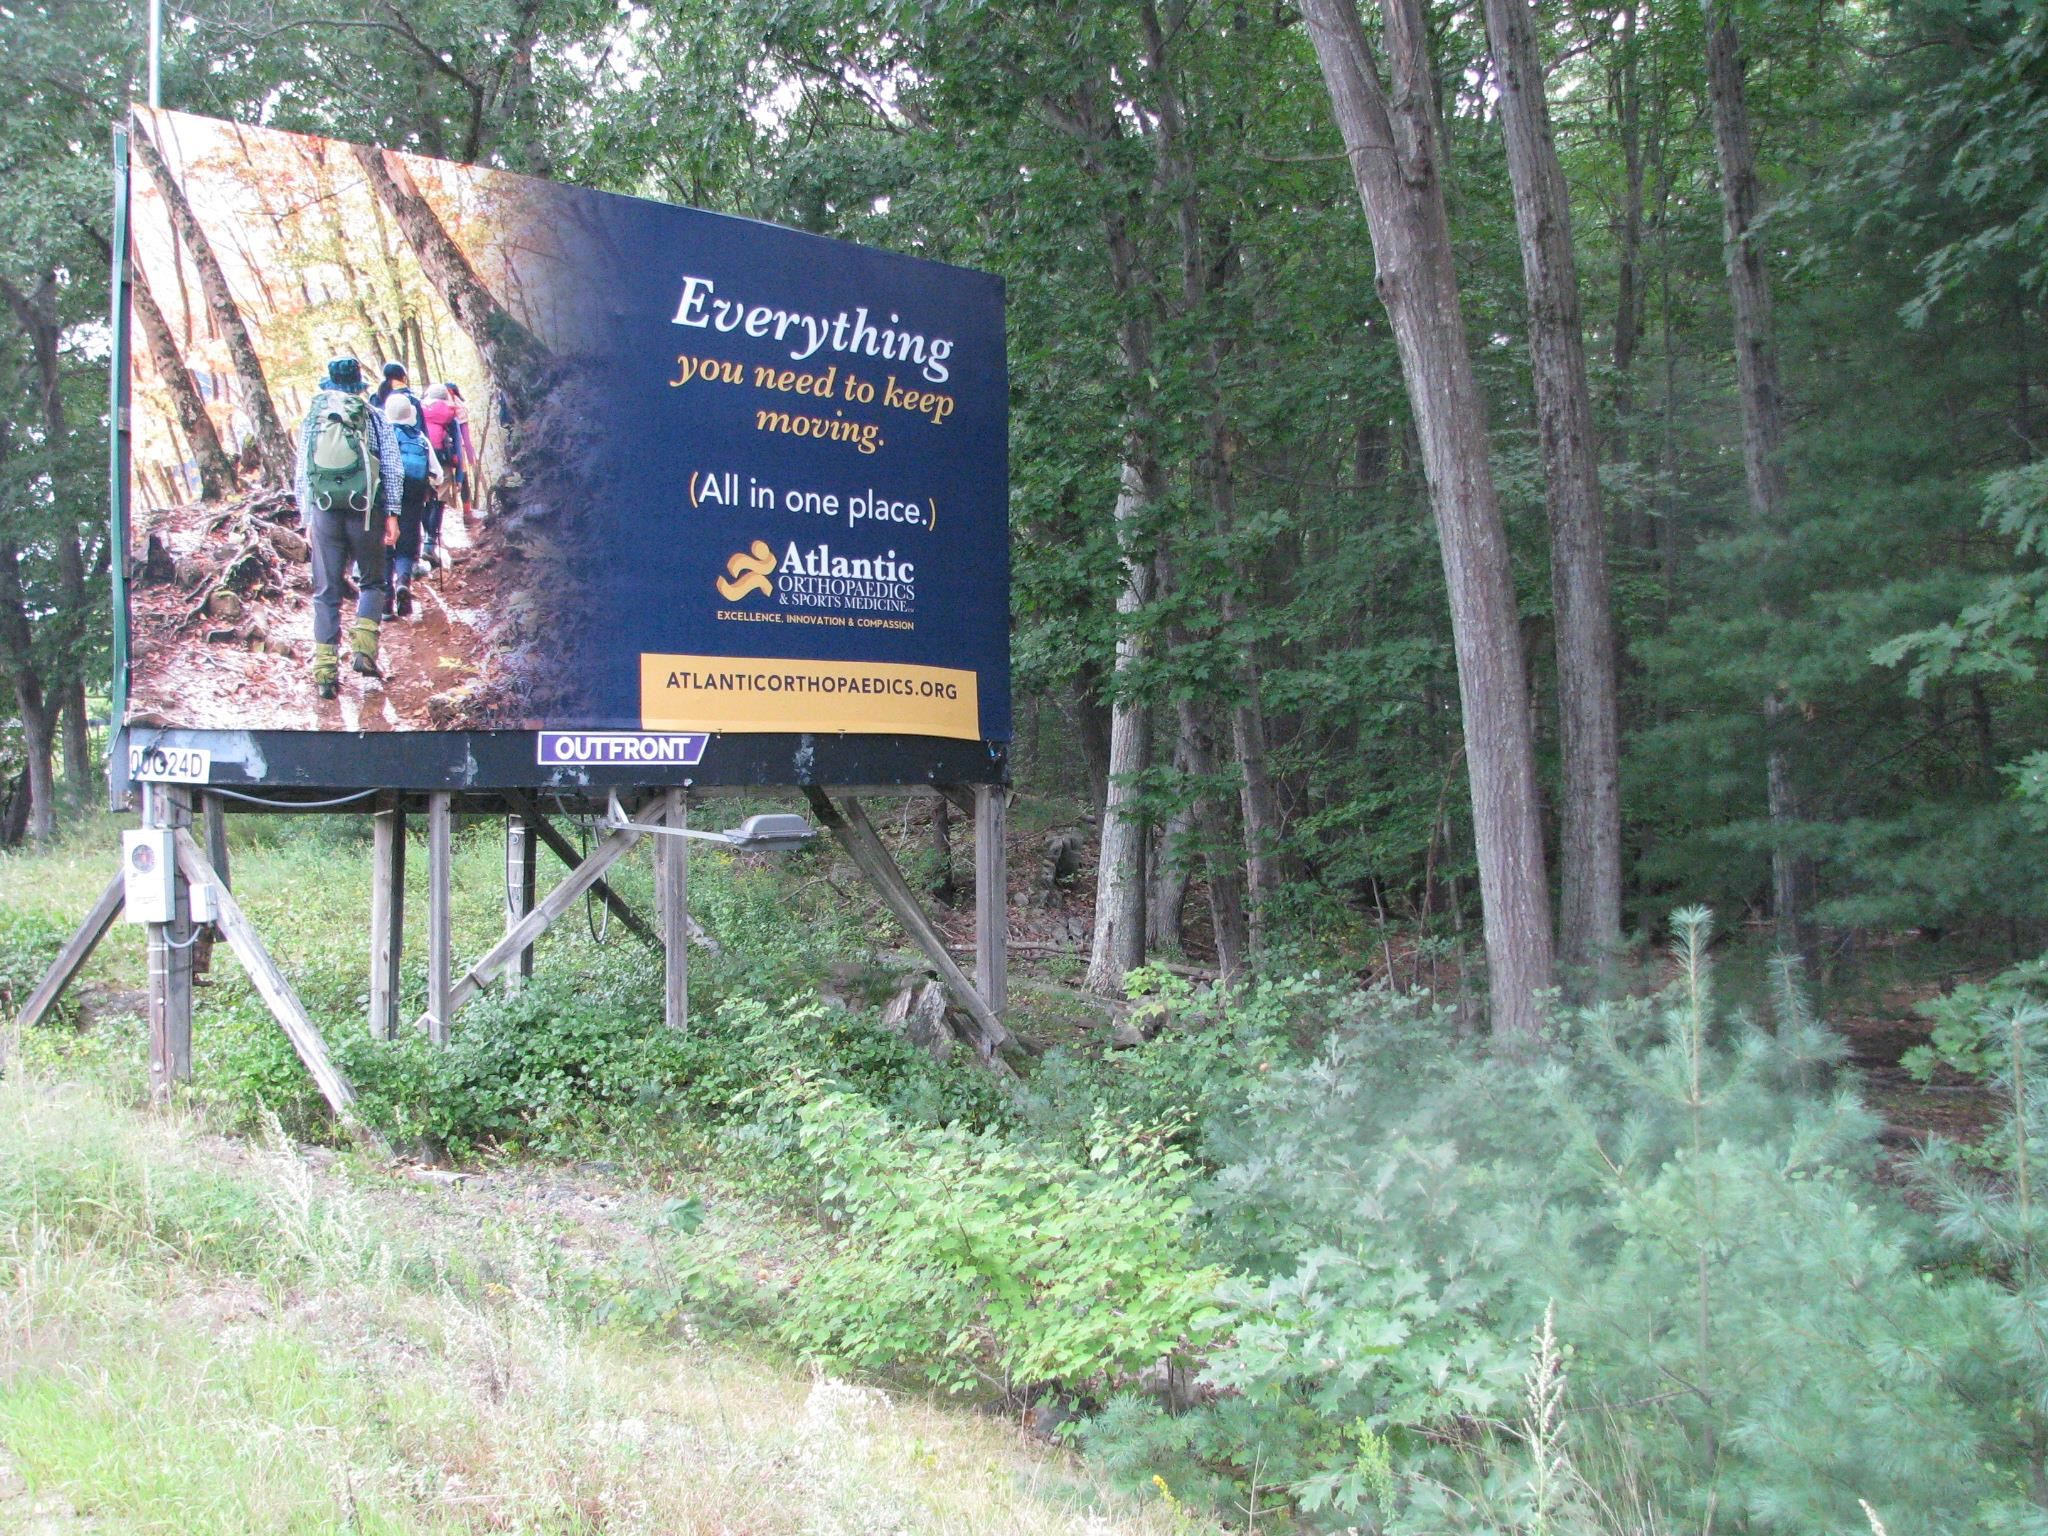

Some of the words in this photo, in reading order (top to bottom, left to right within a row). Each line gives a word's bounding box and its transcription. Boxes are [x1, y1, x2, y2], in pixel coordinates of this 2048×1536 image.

[672, 276, 954, 383] Everything
[670, 355, 744, 387] you
[755, 366, 835, 398] need
[844, 374, 874, 403] to
[883, 376, 955, 424] keep
[756, 410, 884, 454] moving.
[690, 472, 738, 508] (All
[750, 478, 774, 509] in
[785, 490, 839, 516] one
[849, 488, 936, 531] place.)
[779, 541, 915, 583] Atlantic
[778, 575, 915, 600] ORTHOPAEDICS
[779, 594, 789, 605] &
[792, 594, 841, 608] SPORTS
[844, 597, 907, 612] MEDICINE
[717, 611, 784, 623] EXCELLENCE,
[787, 615, 845, 626] INNOVATION
[848, 617, 855, 627] &
[857, 619, 914, 630] COMPASSION
[666, 671, 957, 700] ATLANTICORTHOPAEDICS.ORG
[555, 736, 691, 760] OUTFRONT
